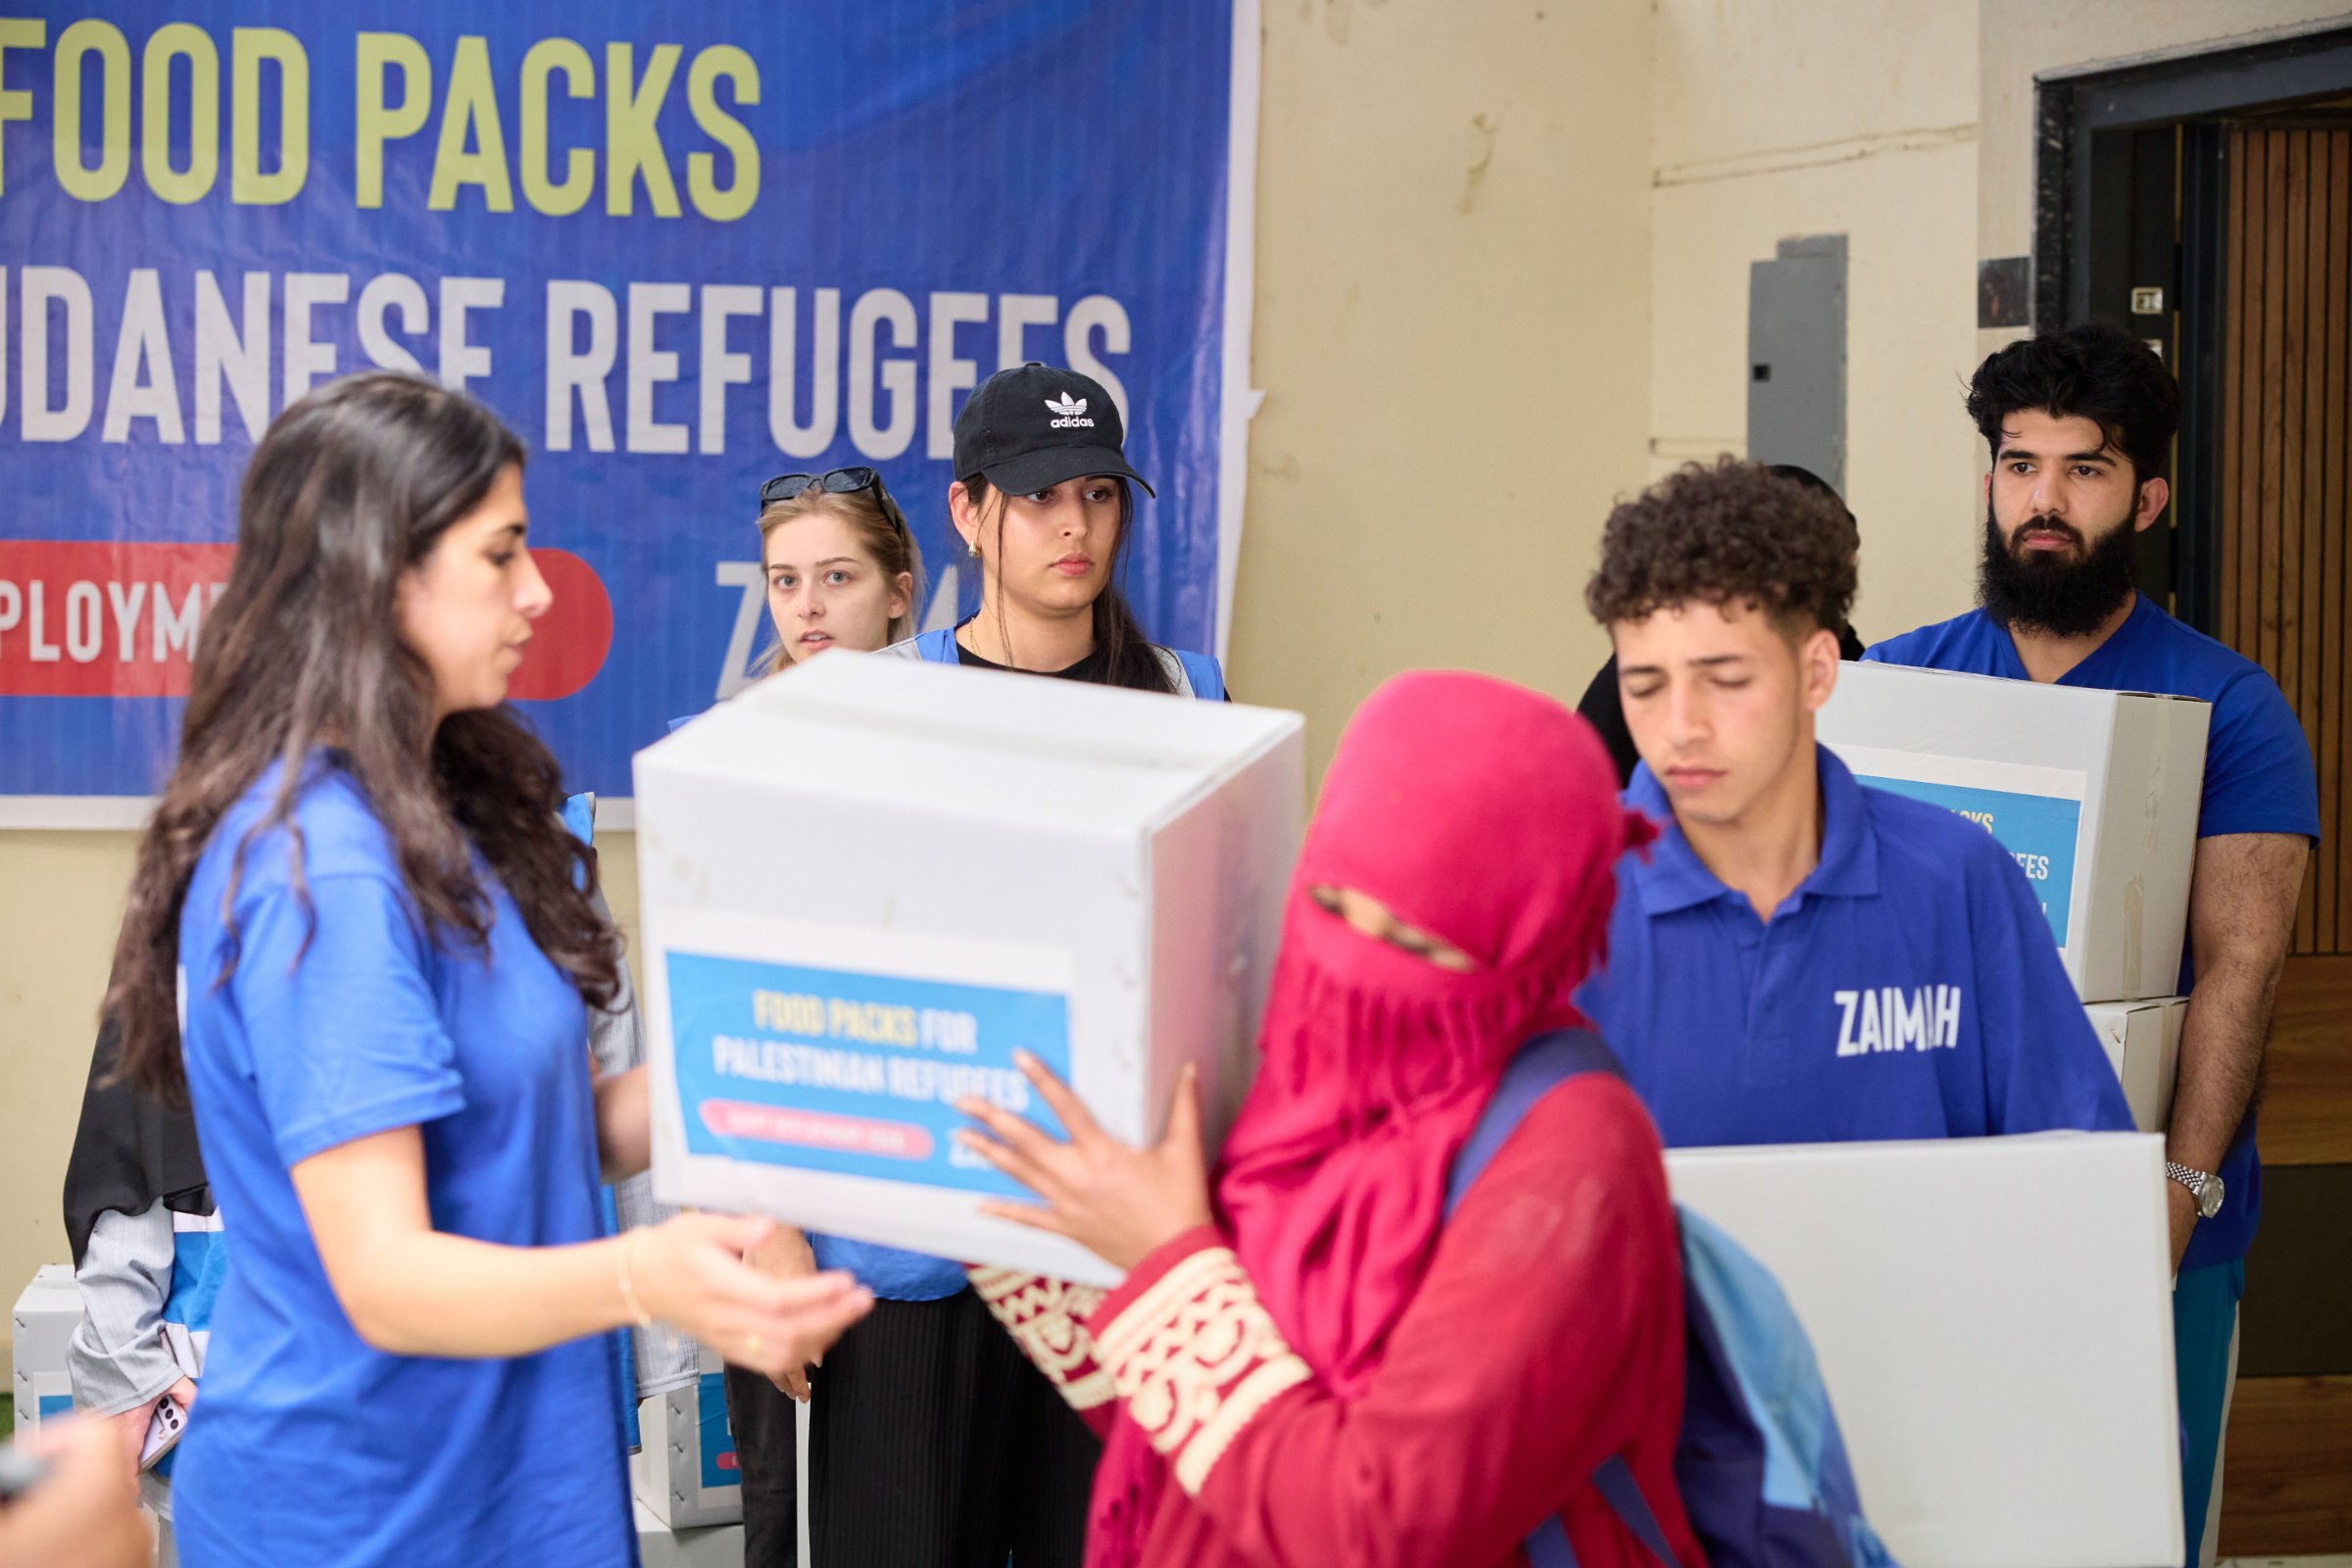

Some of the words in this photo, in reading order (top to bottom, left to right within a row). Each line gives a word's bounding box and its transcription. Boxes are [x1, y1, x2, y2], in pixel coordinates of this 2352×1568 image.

[356, 31, 760, 221] PACKS
[0, 265, 506, 446] DANESE
[1050, 416, 1096, 428] adidas
[0, 579, 228, 663] PLOYM
[753, 989, 825, 1038] FOOD
[828, 998, 919, 1049] PACKS
[920, 1007, 978, 1054] FOR
